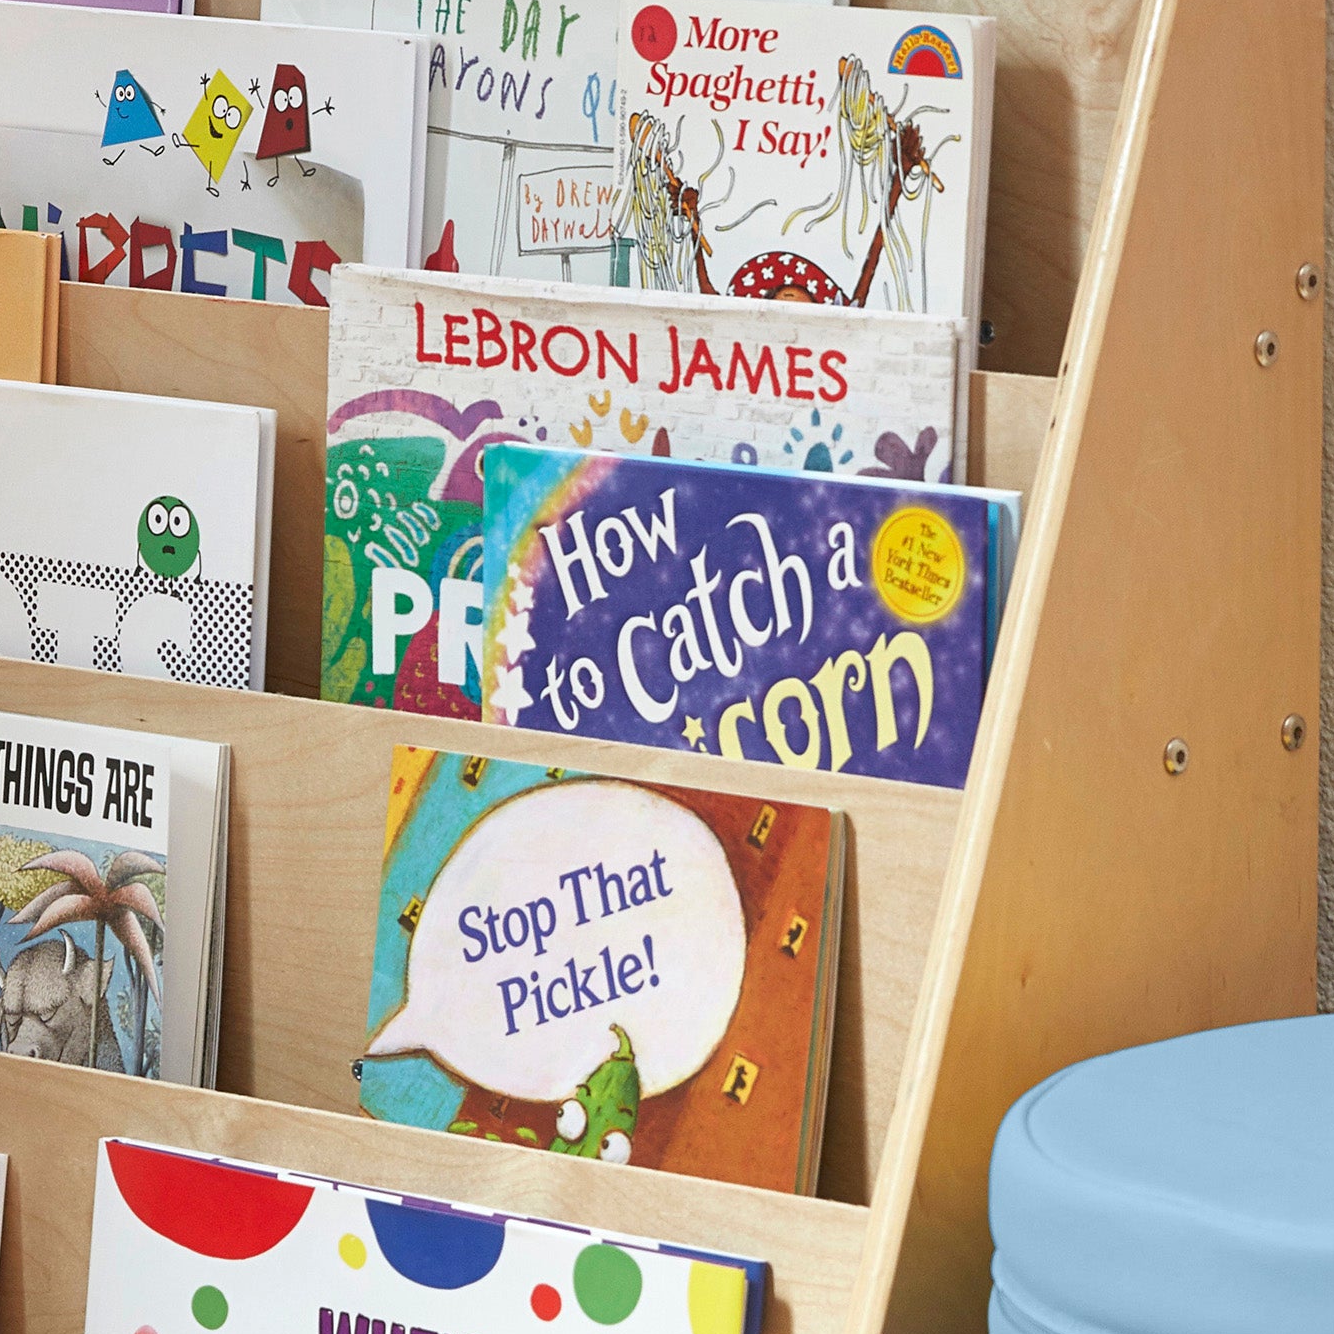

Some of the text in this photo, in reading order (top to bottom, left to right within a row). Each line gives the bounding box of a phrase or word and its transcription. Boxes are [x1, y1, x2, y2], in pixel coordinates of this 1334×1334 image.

[684, 15, 780, 53] More
[645, 61, 827, 113] Spaghetti,
[734, 118, 833, 169] I Say!
[556, 178, 614, 208] DREW
[658, 325, 848, 403] JAMES
[539, 487, 678, 620] How
[540, 513, 862, 731] to Catch a
[681, 631, 934, 773] corn
[102, 757, 154, 828] ARE
[457, 848, 673, 963] Stop That
[497, 934, 661, 1036] Pickle!
